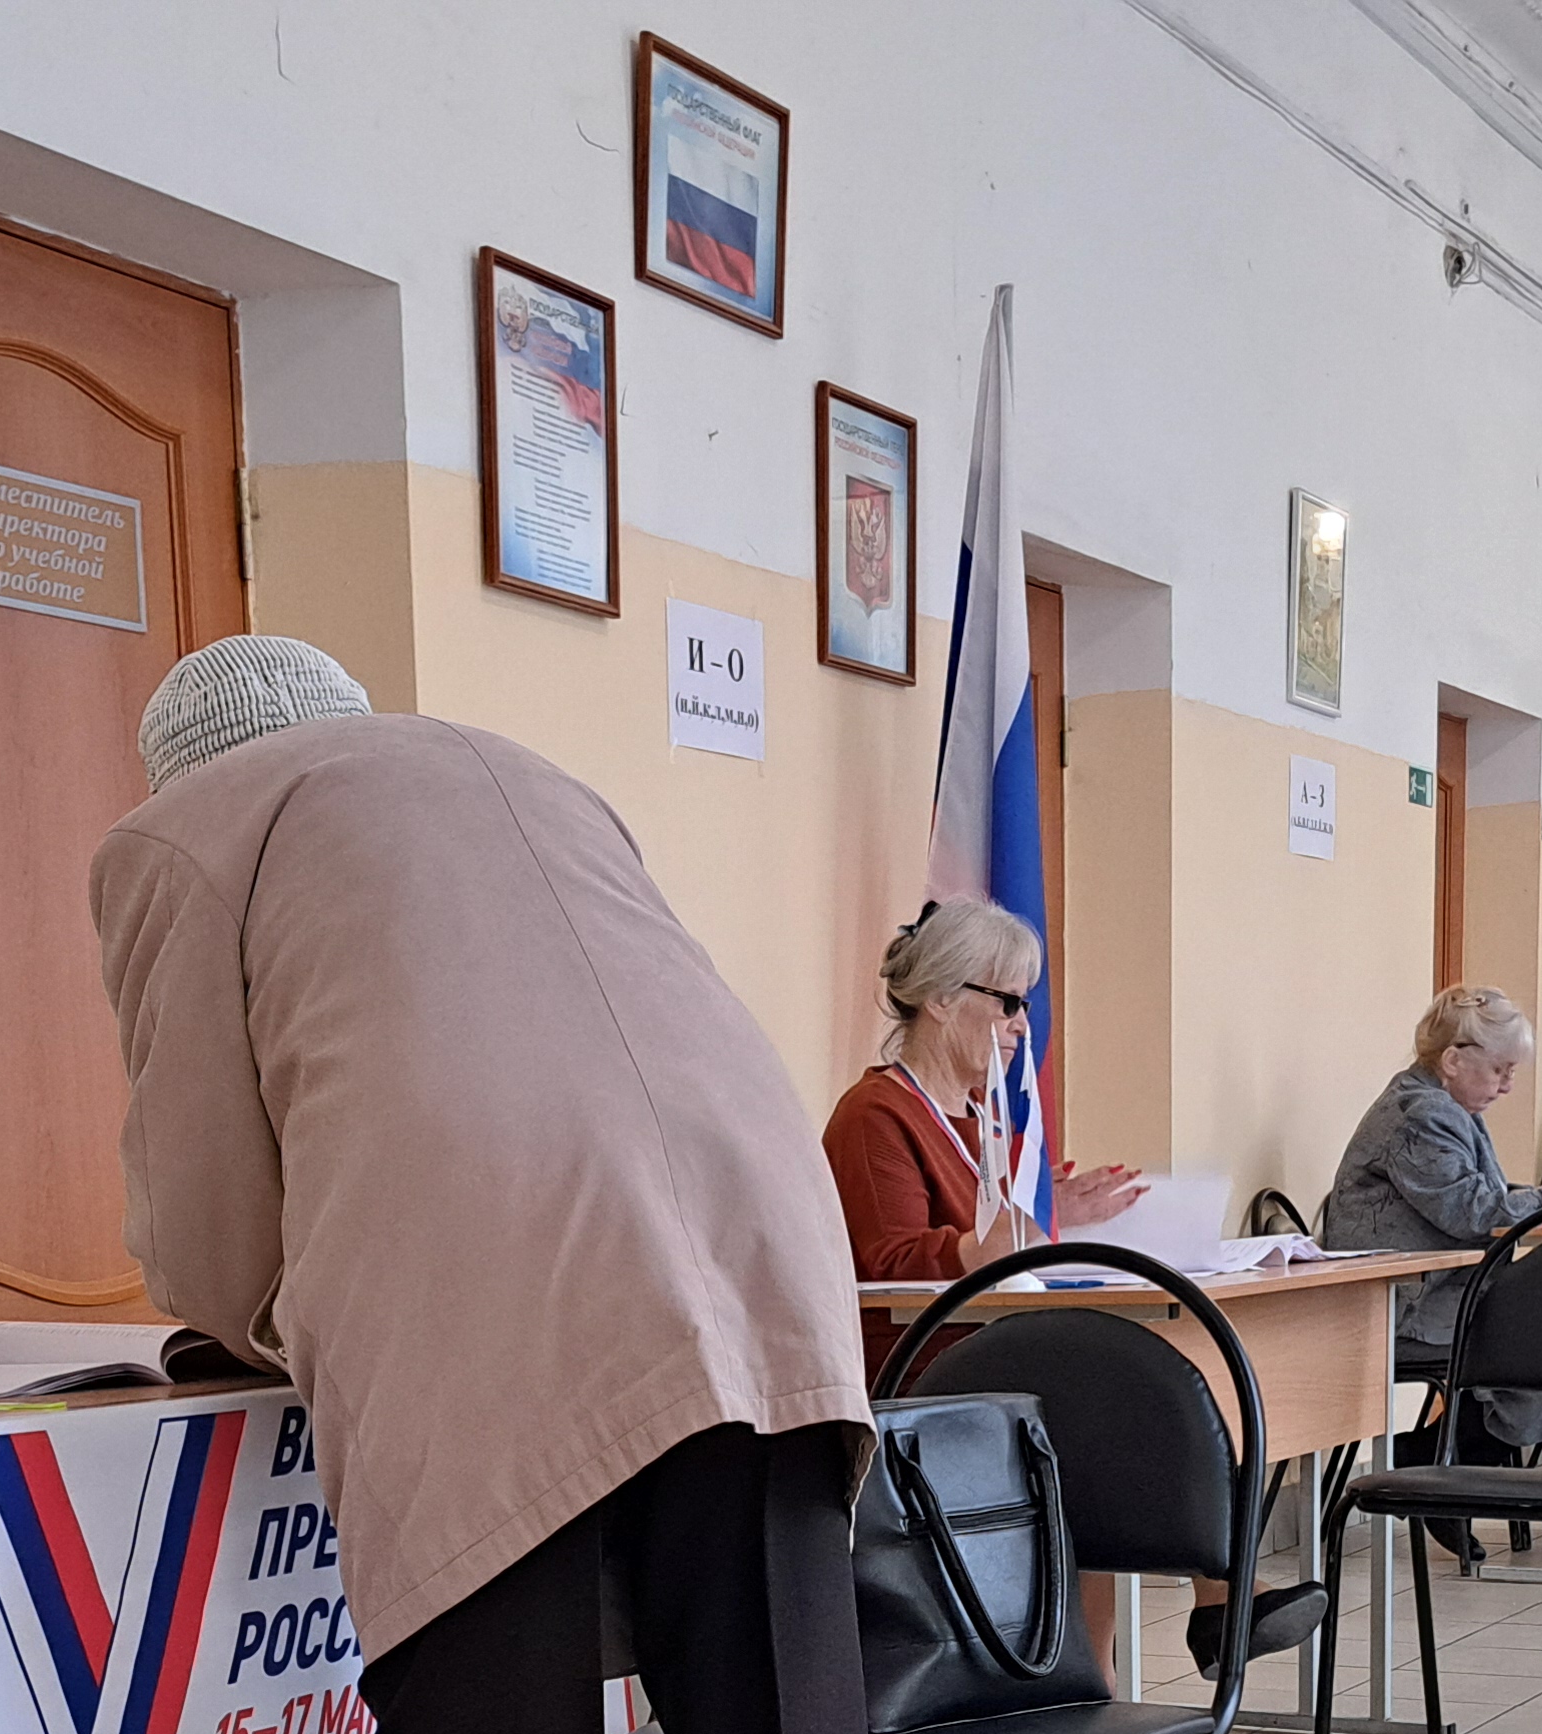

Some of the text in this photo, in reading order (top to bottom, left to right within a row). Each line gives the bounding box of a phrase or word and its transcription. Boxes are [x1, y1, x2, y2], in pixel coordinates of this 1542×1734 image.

[7, 543, 105, 581] учебной
[687, 636, 707, 674] И
[727, 648, 745, 683] О
[270, 1405, 316, 1478] В
[226, 1593, 363, 1685] РОСС
